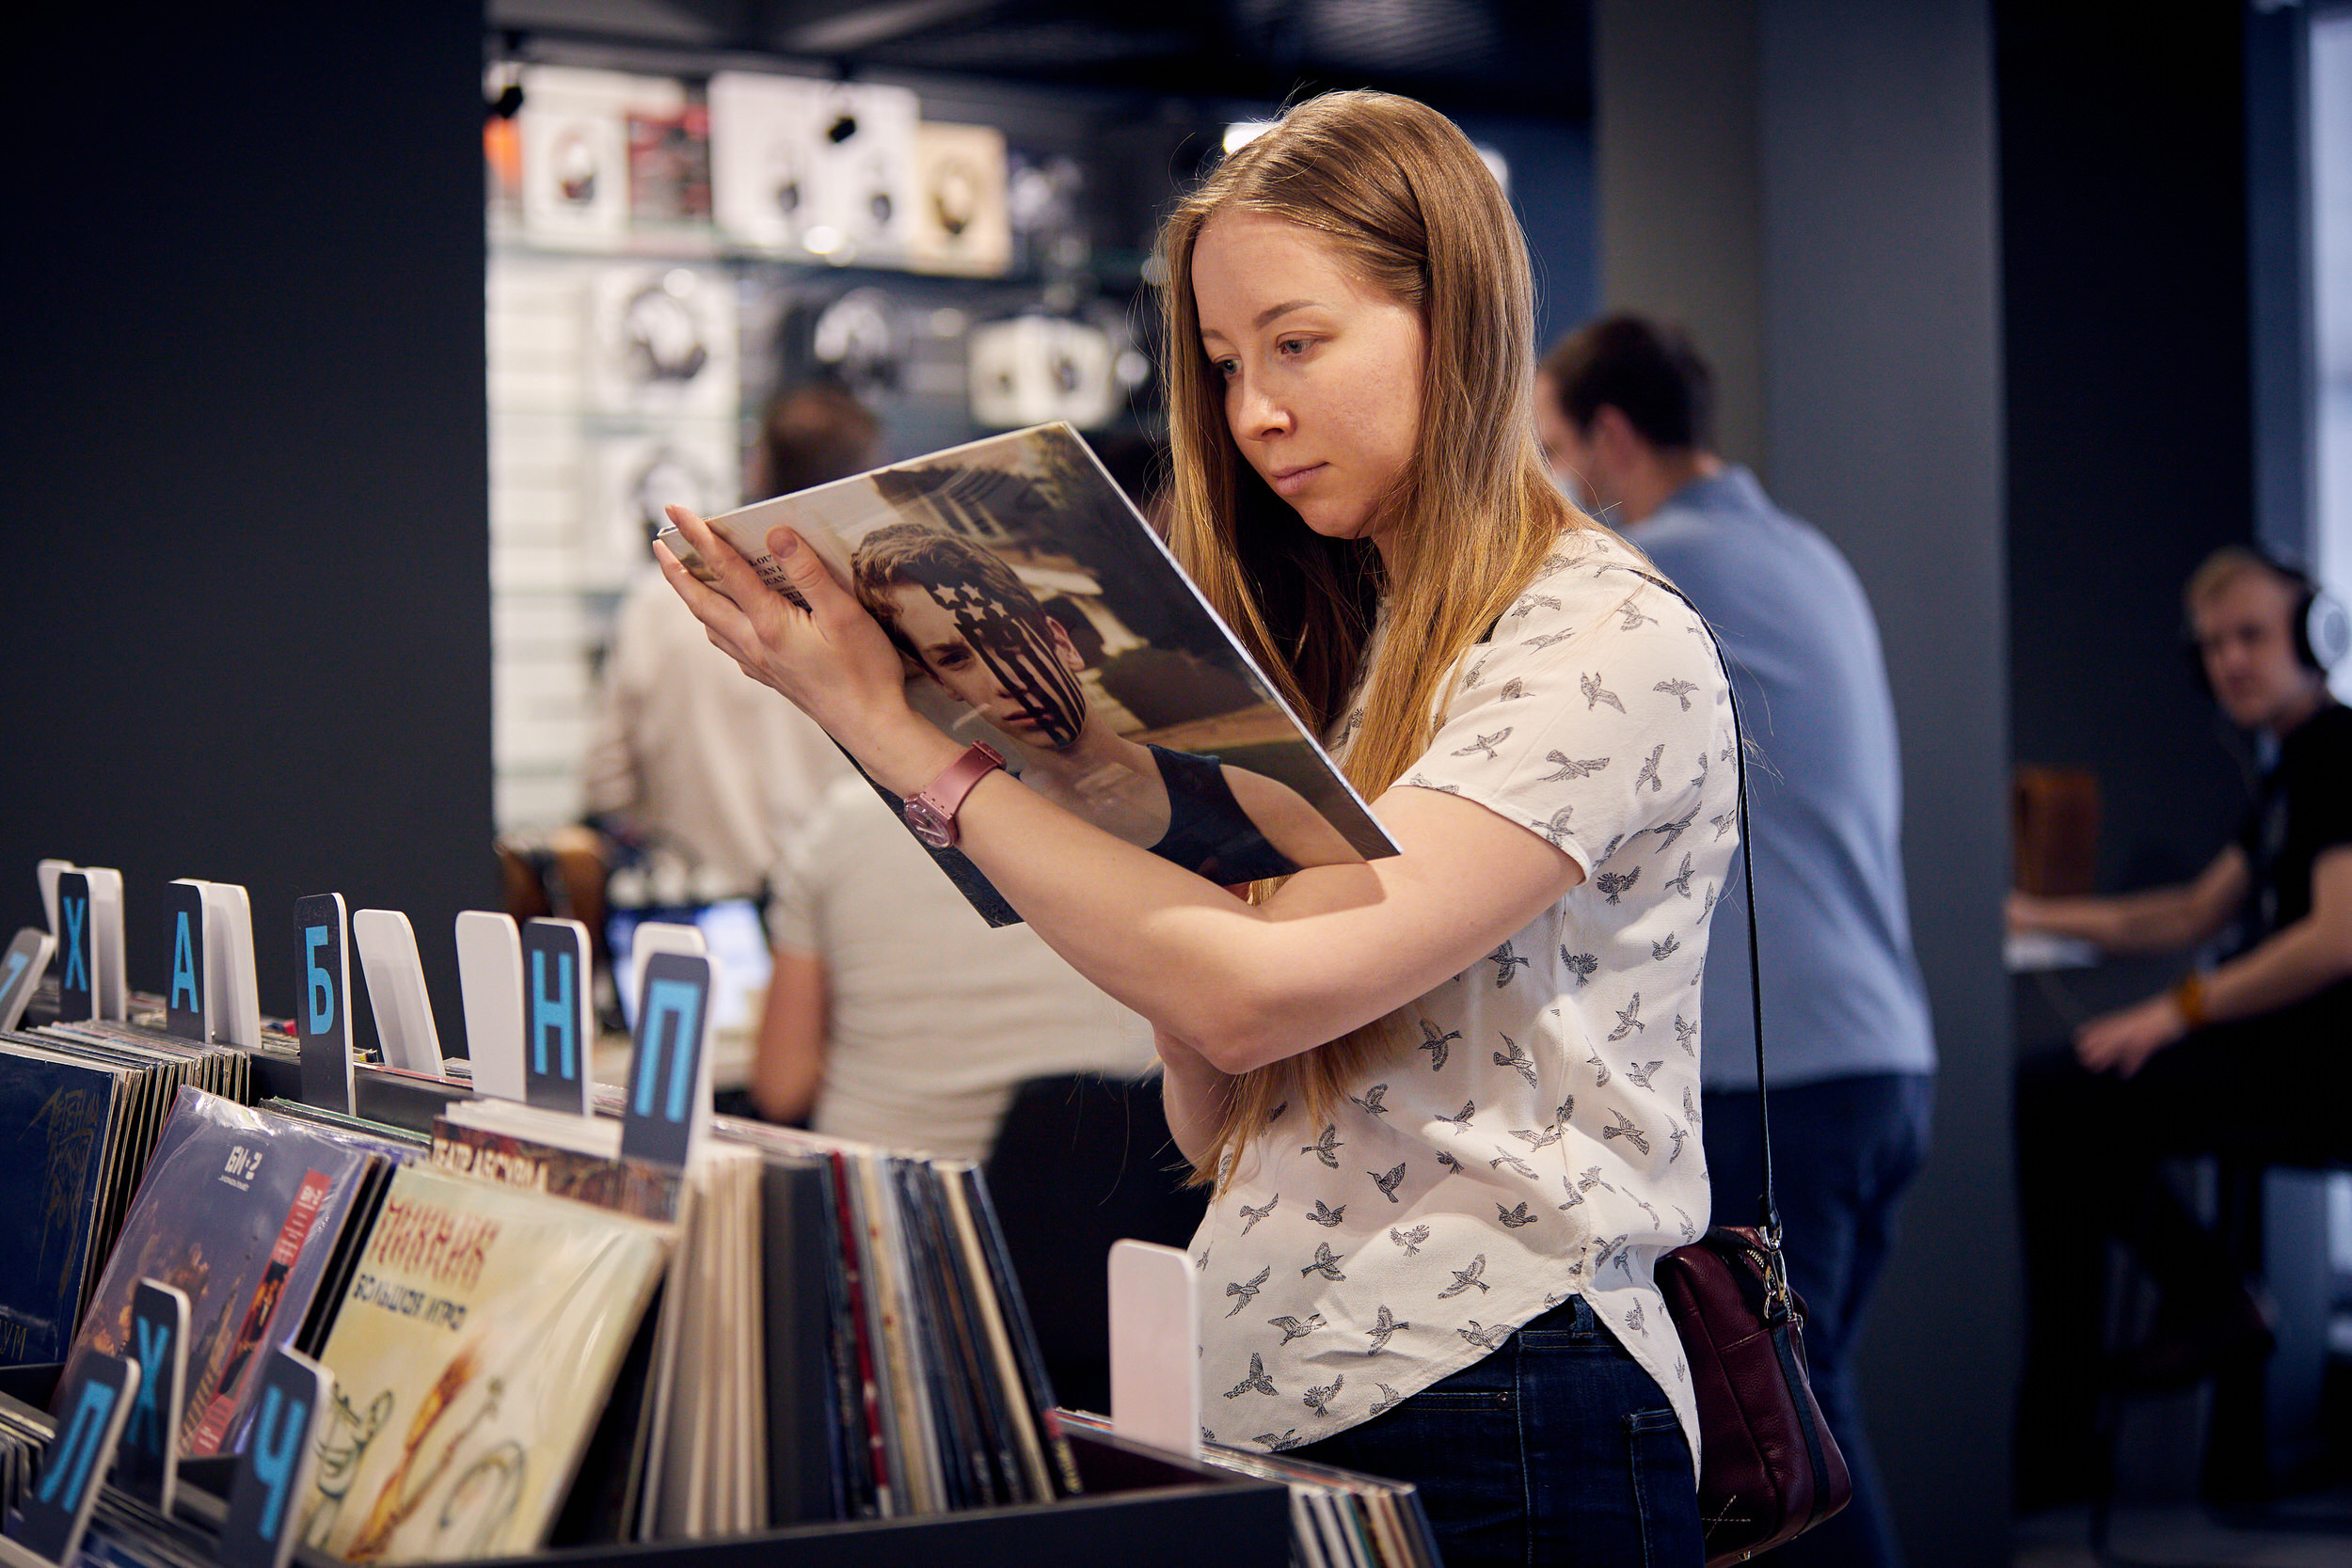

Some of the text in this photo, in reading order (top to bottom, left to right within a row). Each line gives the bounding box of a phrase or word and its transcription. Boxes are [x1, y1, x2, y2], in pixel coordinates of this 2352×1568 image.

[171, 911, 199, 1014] А
[305, 926, 335, 1035] Б
[532, 949, 575, 1081] Н
[635, 978, 701, 1124] П
[253, 1385, 307, 1542] Ч
